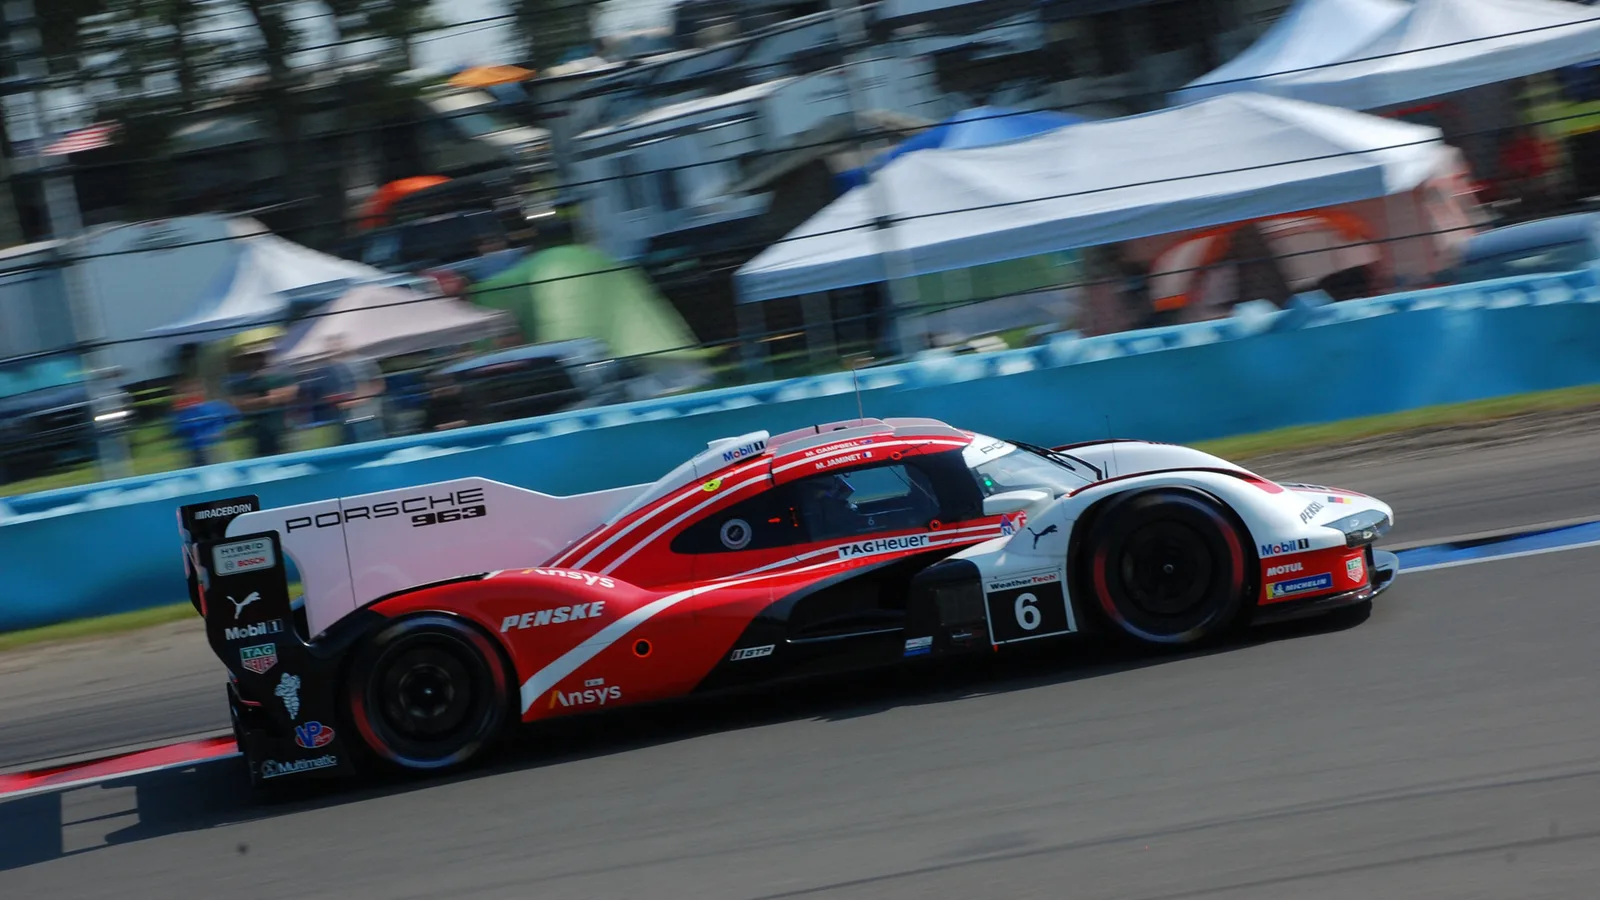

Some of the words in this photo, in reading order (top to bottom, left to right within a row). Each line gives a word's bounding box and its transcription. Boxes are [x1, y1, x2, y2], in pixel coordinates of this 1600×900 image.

[723, 444, 753, 462] Mobil
[816, 441, 860, 454] CAMPBELL
[815, 462, 826, 470] M.
[827, 453, 861, 467] JAMINET
[204, 504, 252, 519] RACEBORN
[285, 488, 485, 533] PORSCHE
[411, 504, 487, 527] 963
[1300, 501, 1325, 524] PENS
[867, 517, 875, 526] 6
[221, 542, 264, 555] HYBRID
[1261, 539, 1297, 556] Mobil
[237, 557, 266, 568] BOSCH
[1266, 562, 1304, 577] MOTUL
[990, 574, 1057, 590] WeatherTech
[1285, 578, 1327, 592] MICHELIN
[500, 601, 606, 633] PENSKE
[1014, 592, 1042, 630] 6
[225, 622, 267, 640] Mobil
[244, 645, 272, 658] TAG
[548, 685, 622, 709] Ansys
[295, 721, 322, 748] VP
[278, 754, 337, 773] Multimatic
